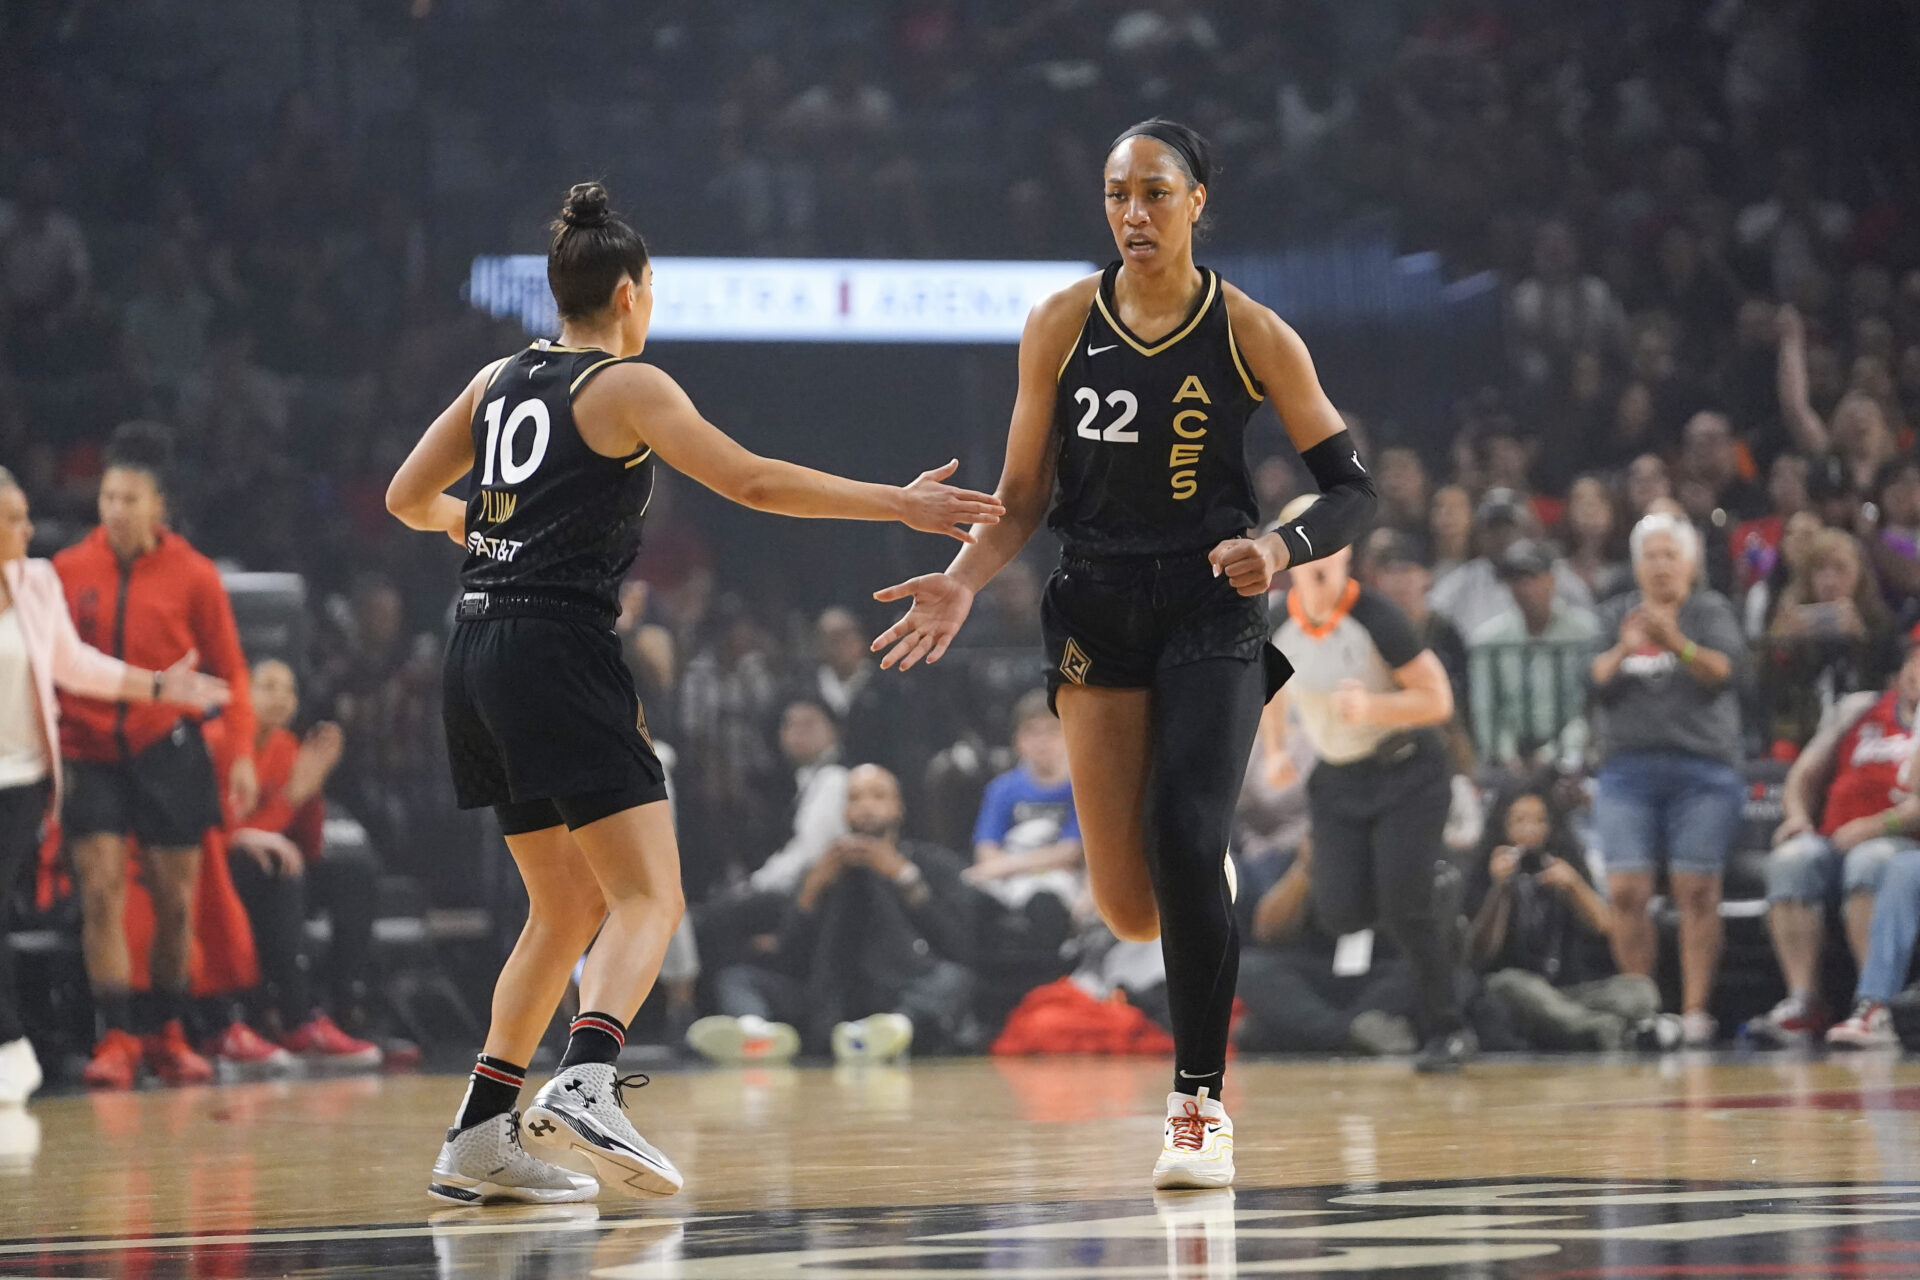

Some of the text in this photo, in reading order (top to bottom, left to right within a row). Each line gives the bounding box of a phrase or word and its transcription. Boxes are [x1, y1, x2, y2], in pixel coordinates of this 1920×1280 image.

[872, 280, 1030, 318] ARENA
[481, 396, 550, 486] 10
[1074, 387, 1139, 443] 22
[1169, 375, 1211, 500] ACES
[476, 536, 523, 562] AT&T
